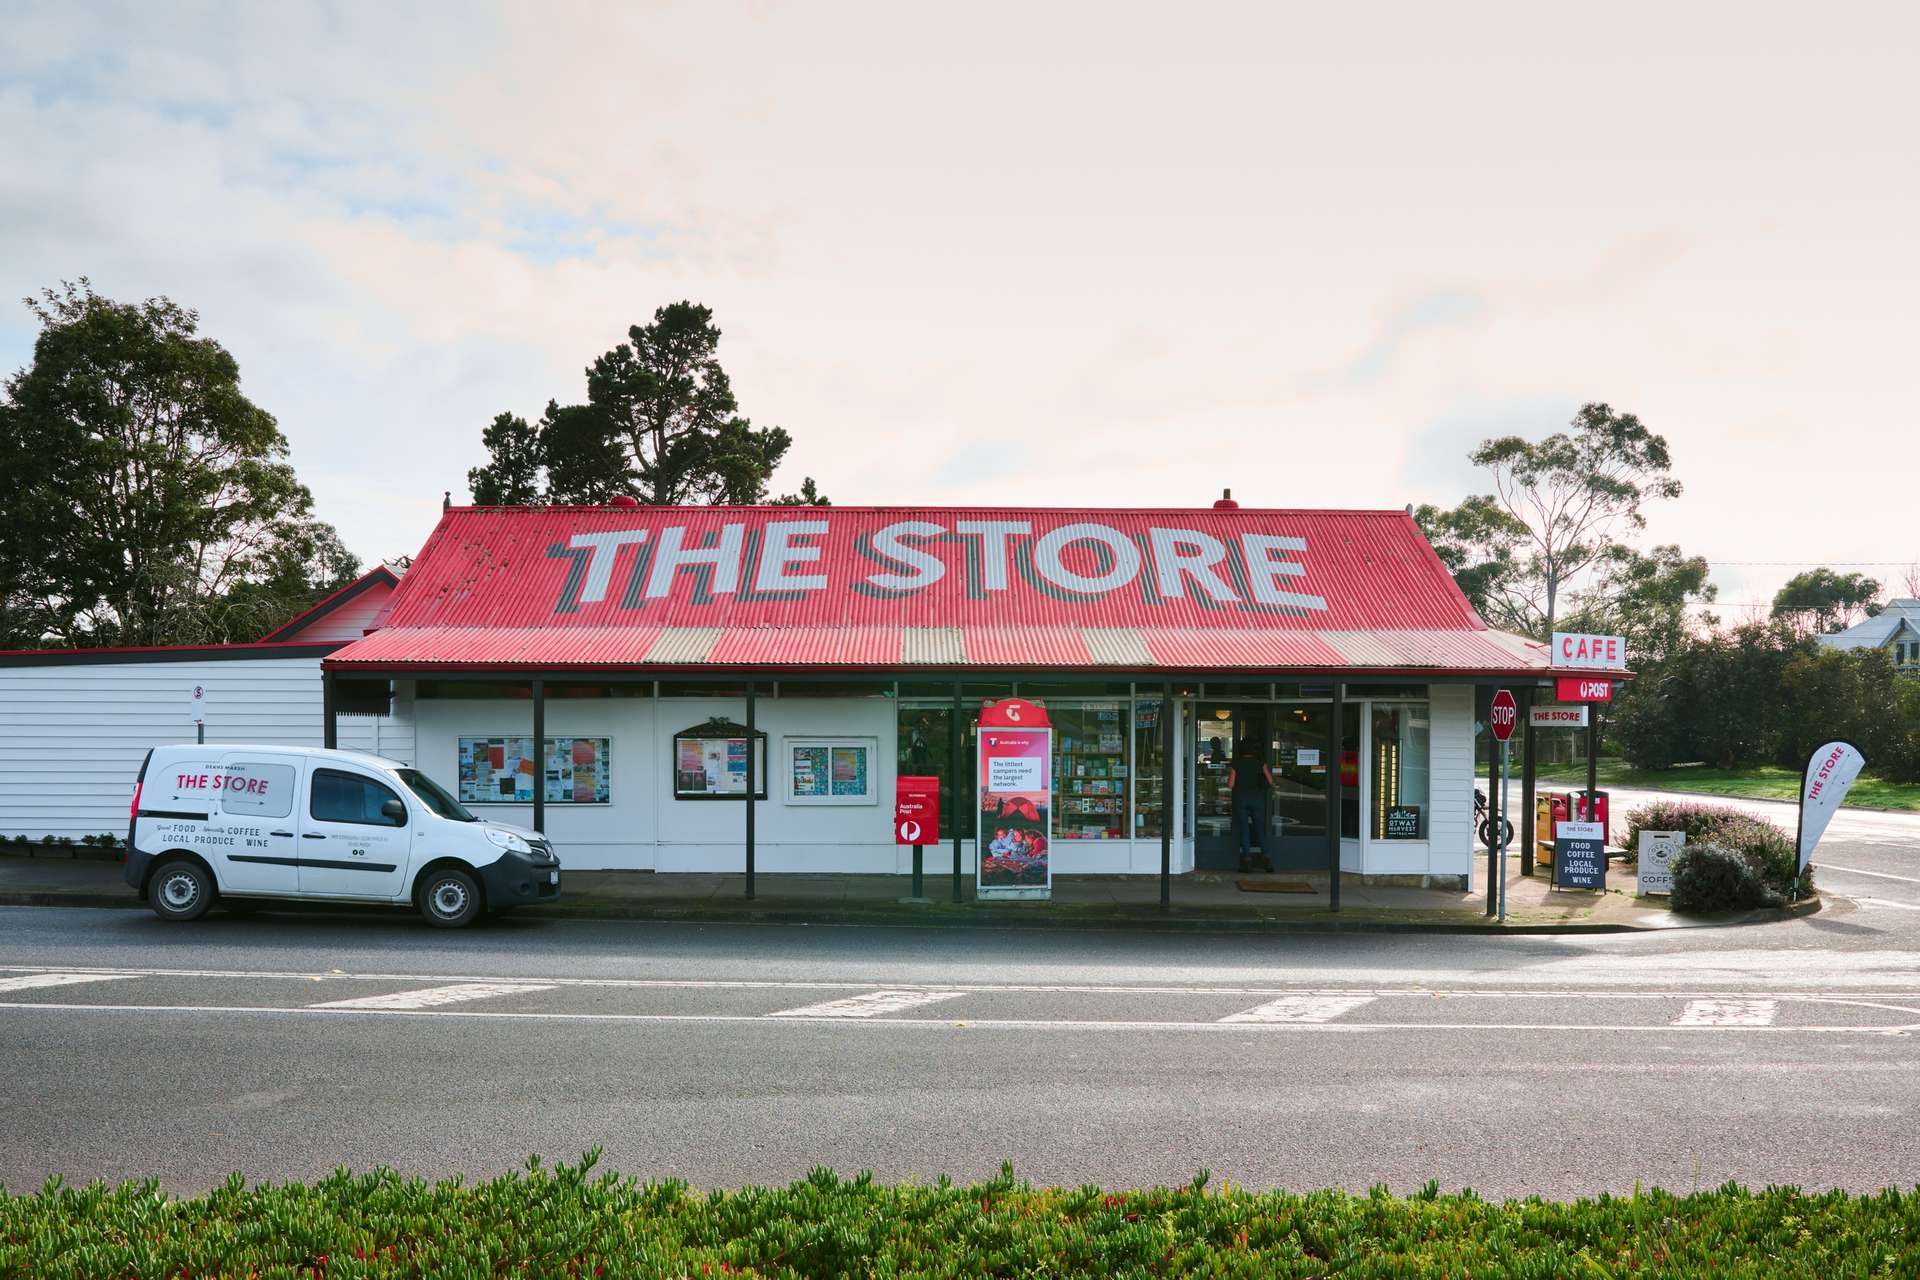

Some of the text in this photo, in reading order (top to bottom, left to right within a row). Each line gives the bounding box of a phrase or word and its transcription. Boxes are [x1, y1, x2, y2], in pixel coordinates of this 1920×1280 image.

[568, 519, 1329, 611] THE STORE
[1562, 637, 1617, 660] CAFE
[1588, 682, 1609, 697] POST
[1493, 706, 1515, 725] STOP
[1534, 711, 1580, 721] THE STORE
[1004, 774, 1023, 782] largest
[1808, 780, 1824, 801] THE
[1818, 746, 1845, 780] STORE
[177, 775, 269, 795] THE STORE
[173, 824, 196, 833] FOOD
[227, 827, 260, 837] COFFEE
[162, 834, 269, 847] LOCAL PRODUCE WINE
[1567, 851, 1595, 859] COFFEE
[1564, 866, 1599, 875] PRODUCE
[1569, 860, 1594, 868] LOCAL
[1572, 876, 1592, 884] WINE
